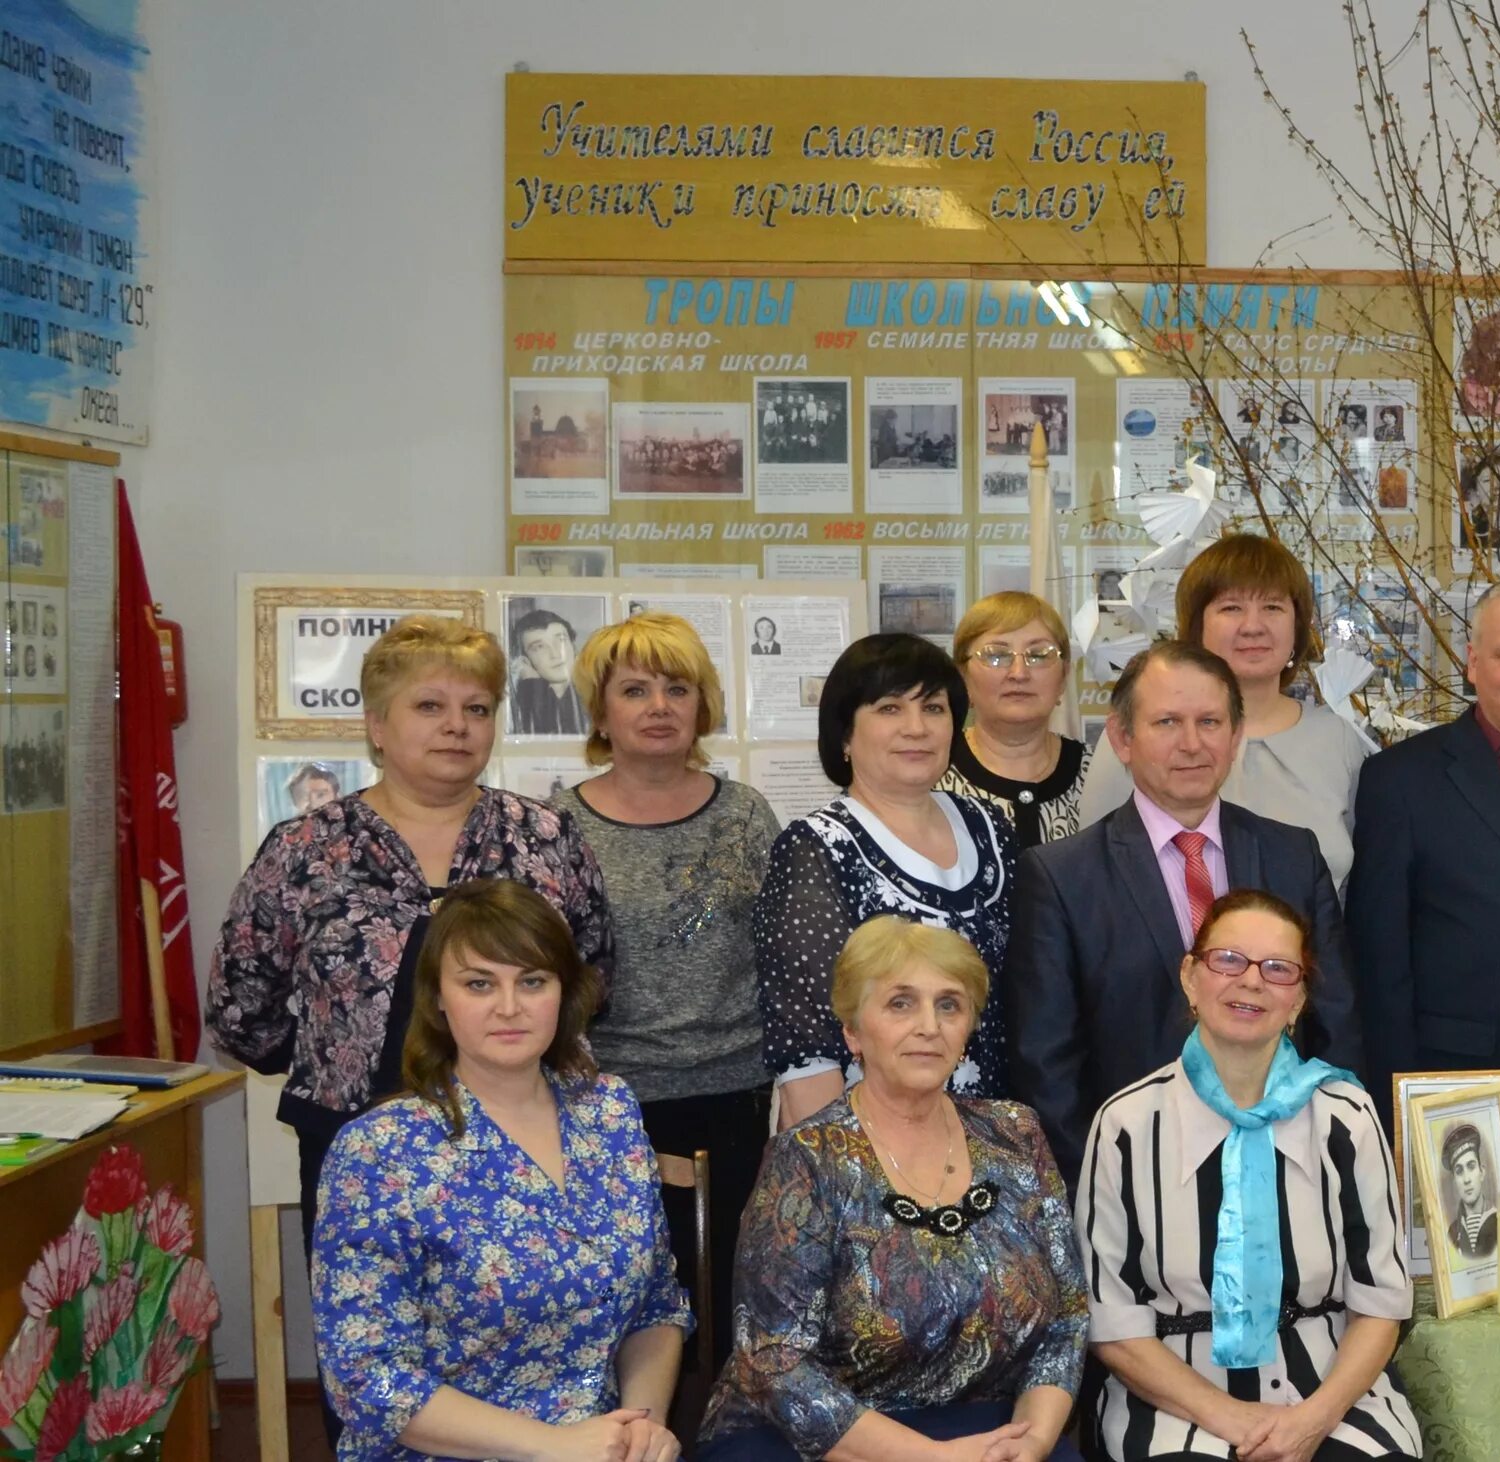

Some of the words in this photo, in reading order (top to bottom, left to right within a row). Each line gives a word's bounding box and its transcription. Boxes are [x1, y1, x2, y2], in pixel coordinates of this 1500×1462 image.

[540, 99, 775, 161] Учителями
[802, 119, 996, 160] славится
[990, 180, 1107, 232] славу
[1143, 176, 1188, 222] ей
[644, 278, 796, 327] ТРОПЫ
[844, 279, 1092, 328] ШКОЛЬНО
[1139, 282, 1321, 330] ПАМЯТИ
[573, 331, 722, 352] ЦЕРКОВНО-
[1047, 331, 1137, 350] ШКО
[531, 353, 706, 373] ПРИХОДСКАЯ
[719, 354, 809, 372] ШКОЛА
[567, 522, 714, 541] НАЧАЛЬНАЯ
[721, 522, 809, 540] ШКОЛА
